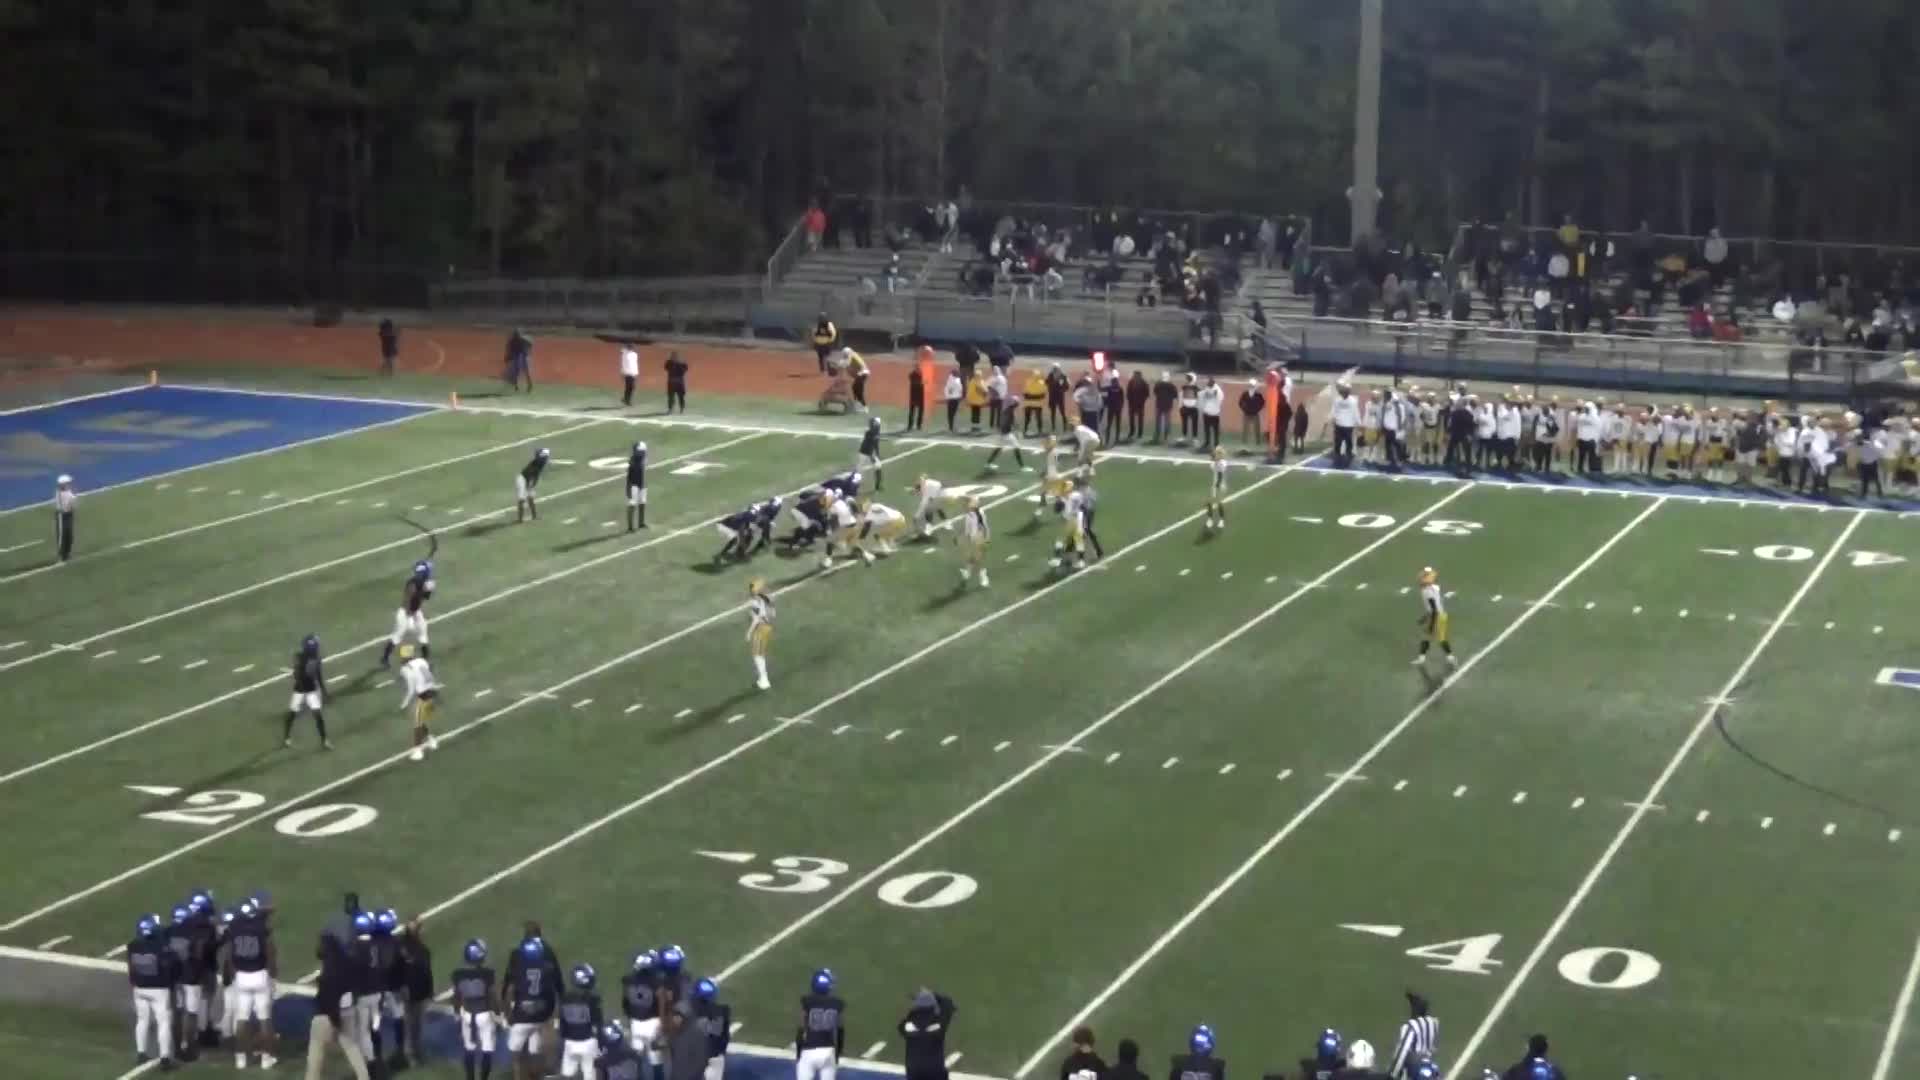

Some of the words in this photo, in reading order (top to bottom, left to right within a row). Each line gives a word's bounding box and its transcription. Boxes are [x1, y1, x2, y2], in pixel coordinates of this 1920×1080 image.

[1338, 513, 1483, 535] 30
[1753, 545, 1906, 566] 40
[141, 789, 378, 837] 20
[738, 856, 978, 908] 30
[1405, 932, 1661, 989] 40
[526, 968, 541, 996] 7
